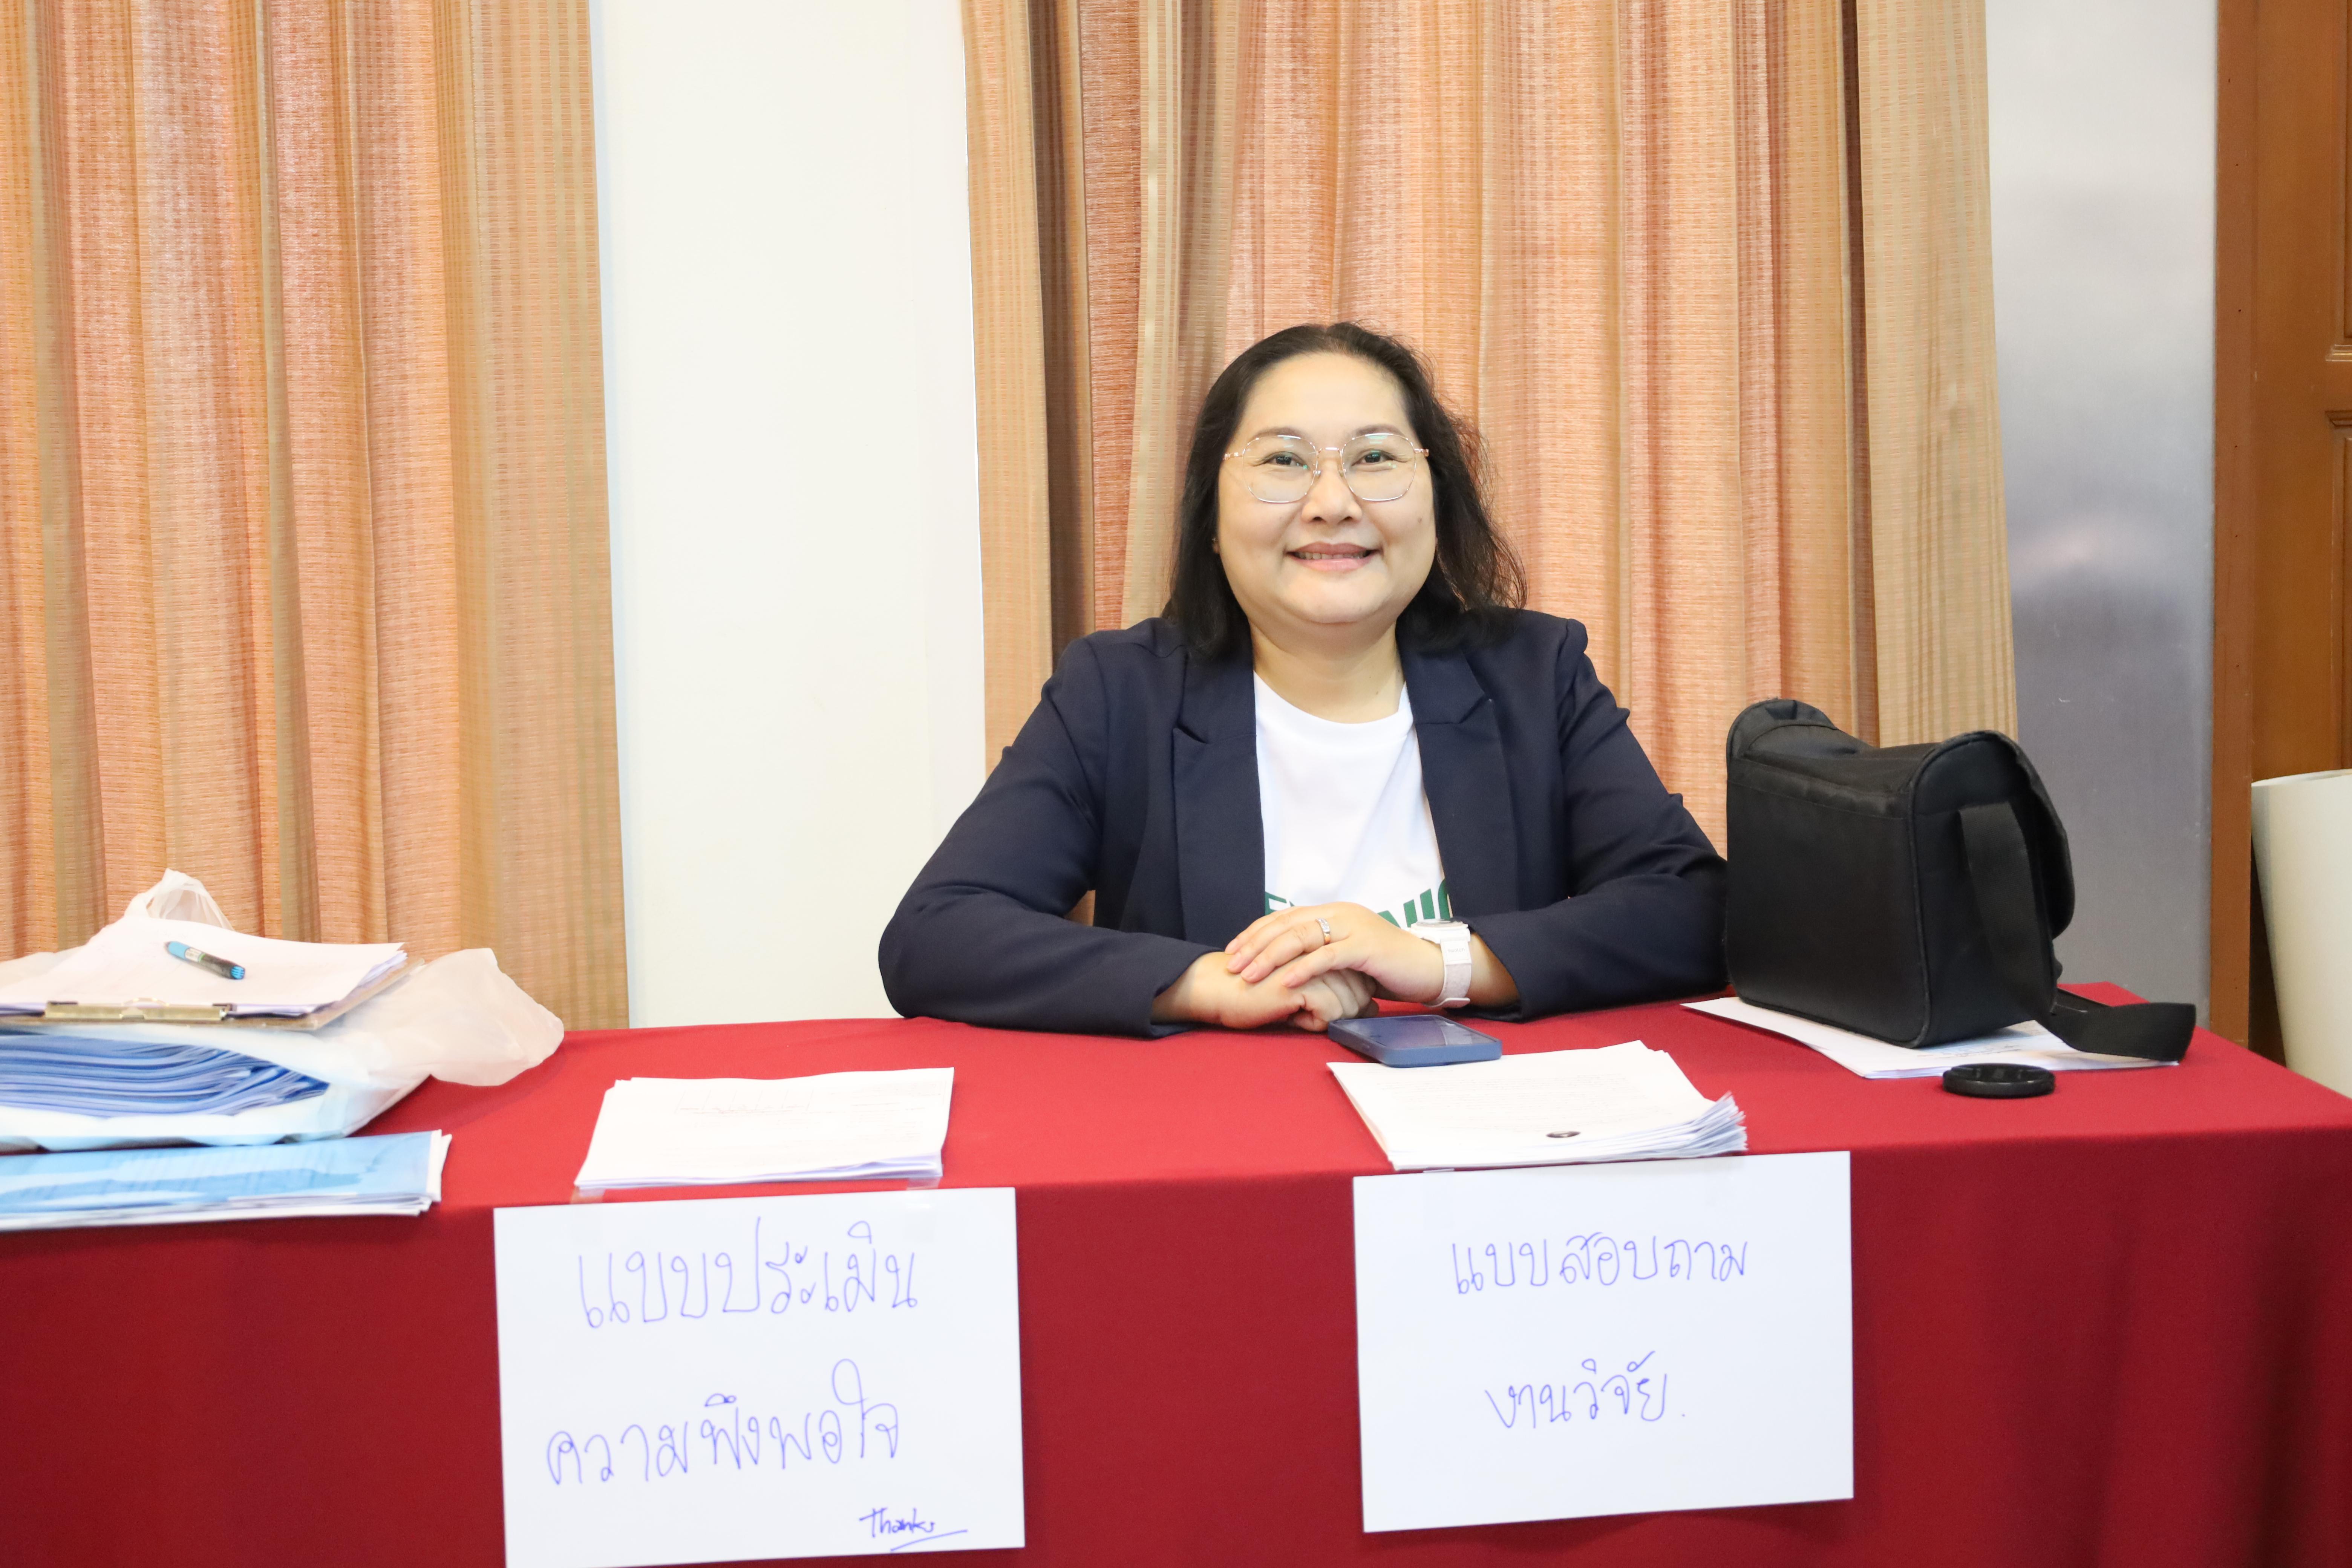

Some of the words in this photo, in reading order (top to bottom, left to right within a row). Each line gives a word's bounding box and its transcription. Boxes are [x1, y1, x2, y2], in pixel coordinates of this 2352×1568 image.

[579, 1217, 917, 1328] แบบประเมิน
[1452, 1232, 1747, 1294] แบบสอบถาม
